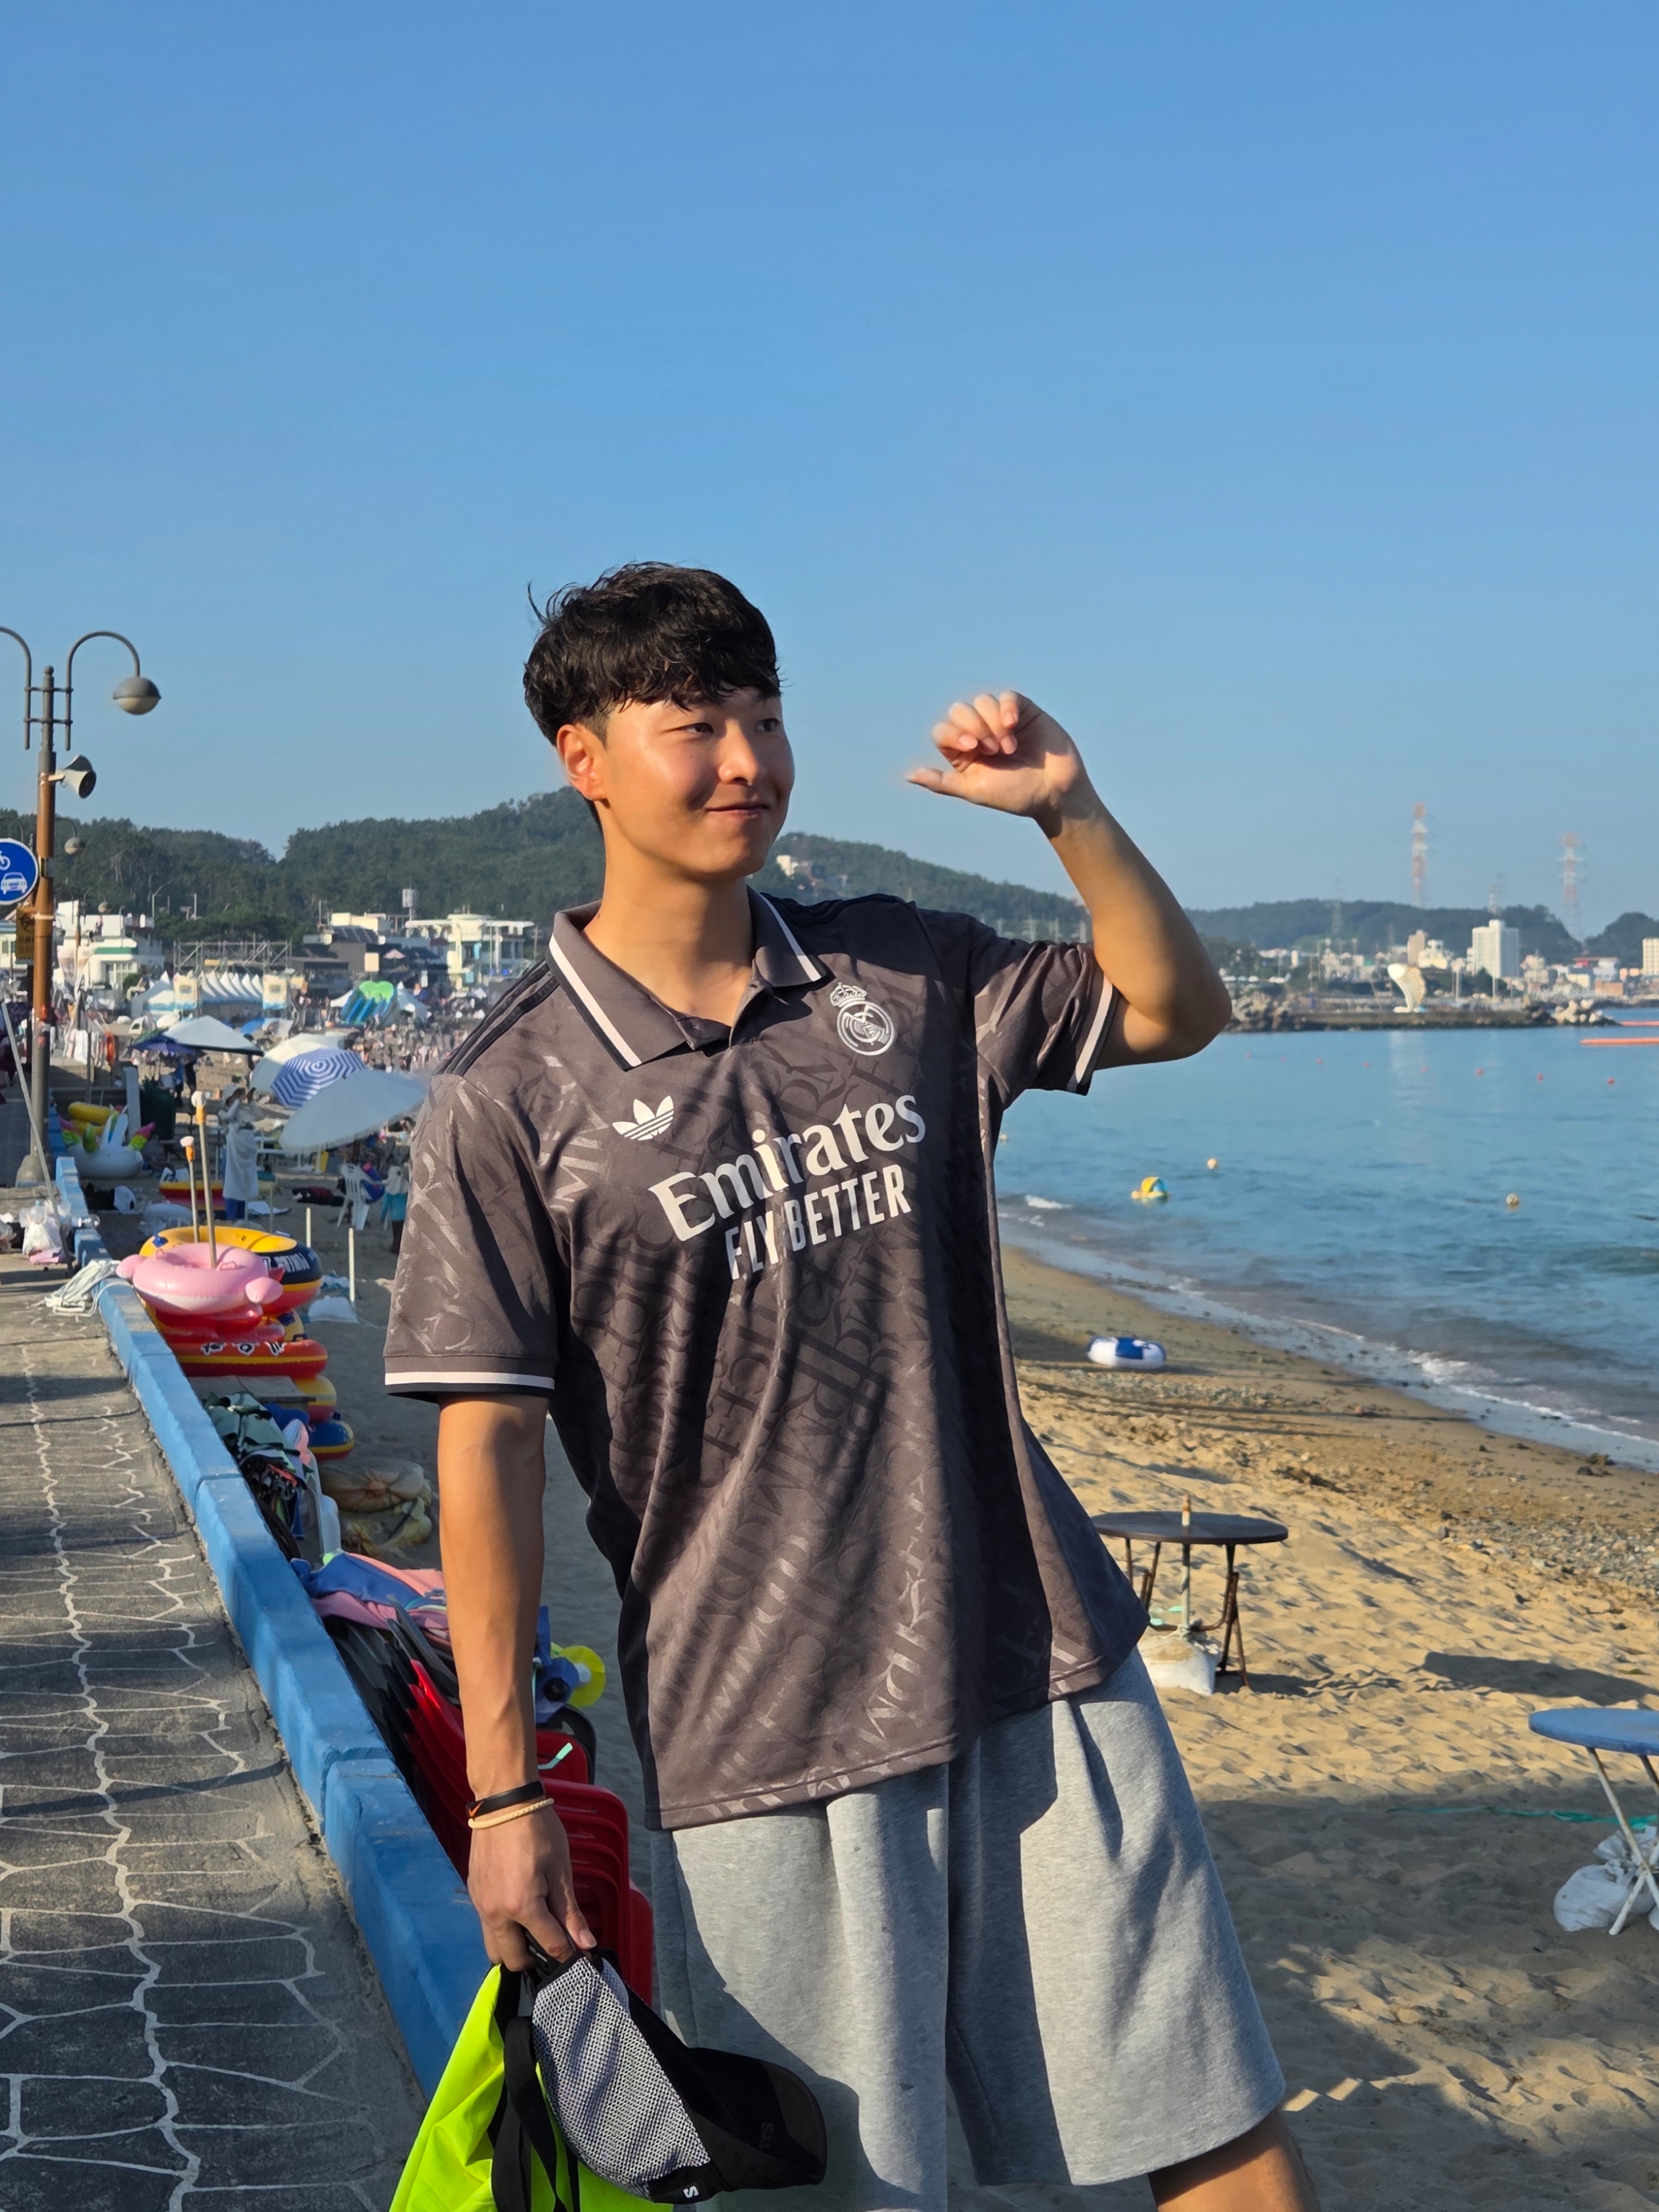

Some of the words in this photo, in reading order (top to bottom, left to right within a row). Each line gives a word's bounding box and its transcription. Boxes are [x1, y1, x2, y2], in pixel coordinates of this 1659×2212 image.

[648, 1095, 926, 1242] Emirates
[725, 1210, 780, 1280] FLY
[784, 1164, 912, 1252] BETTER
